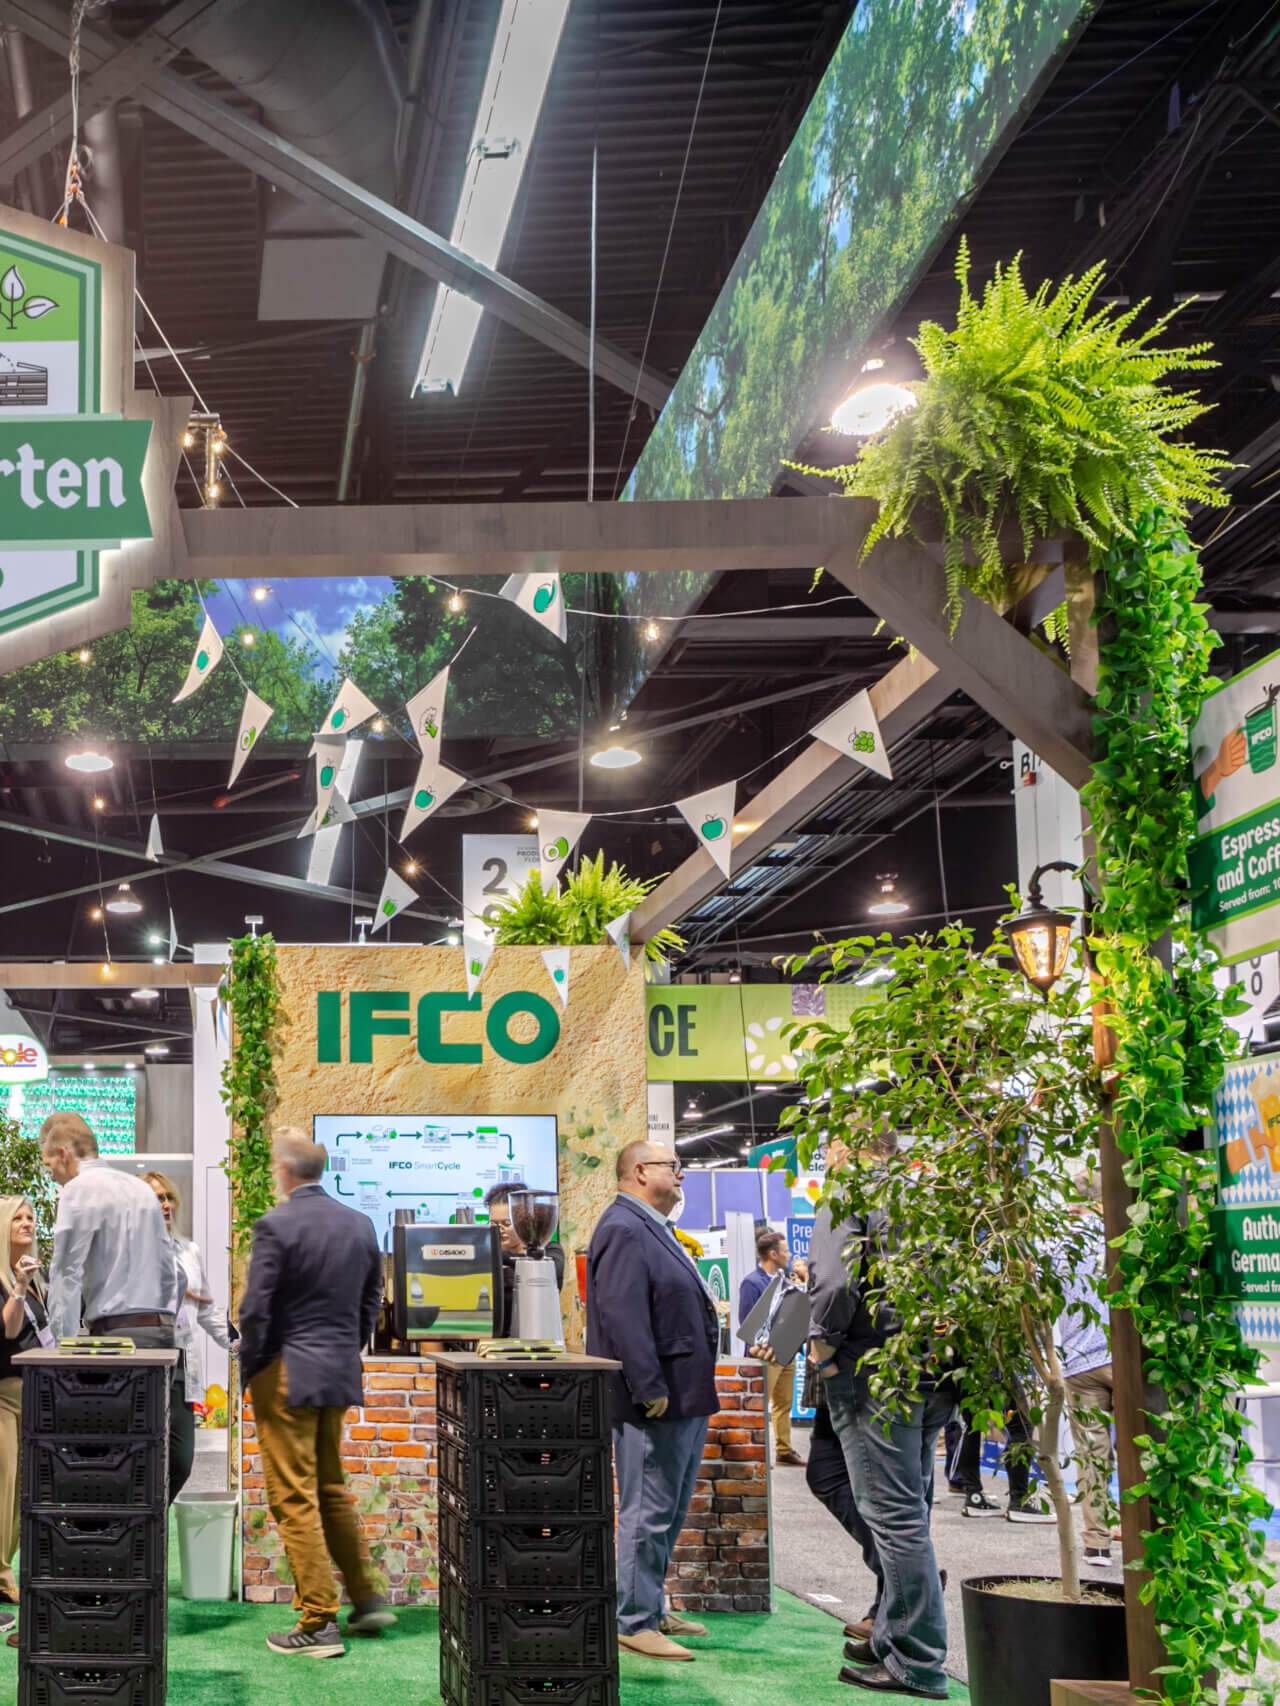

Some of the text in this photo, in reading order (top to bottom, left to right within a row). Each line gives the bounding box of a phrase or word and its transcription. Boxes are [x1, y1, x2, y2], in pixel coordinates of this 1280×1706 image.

[1216, 860, 1245, 894] and
[317, 990, 561, 1065] IFCO
[648, 1003, 698, 1057] CE
[388, 1161, 413, 1170] IFCO
